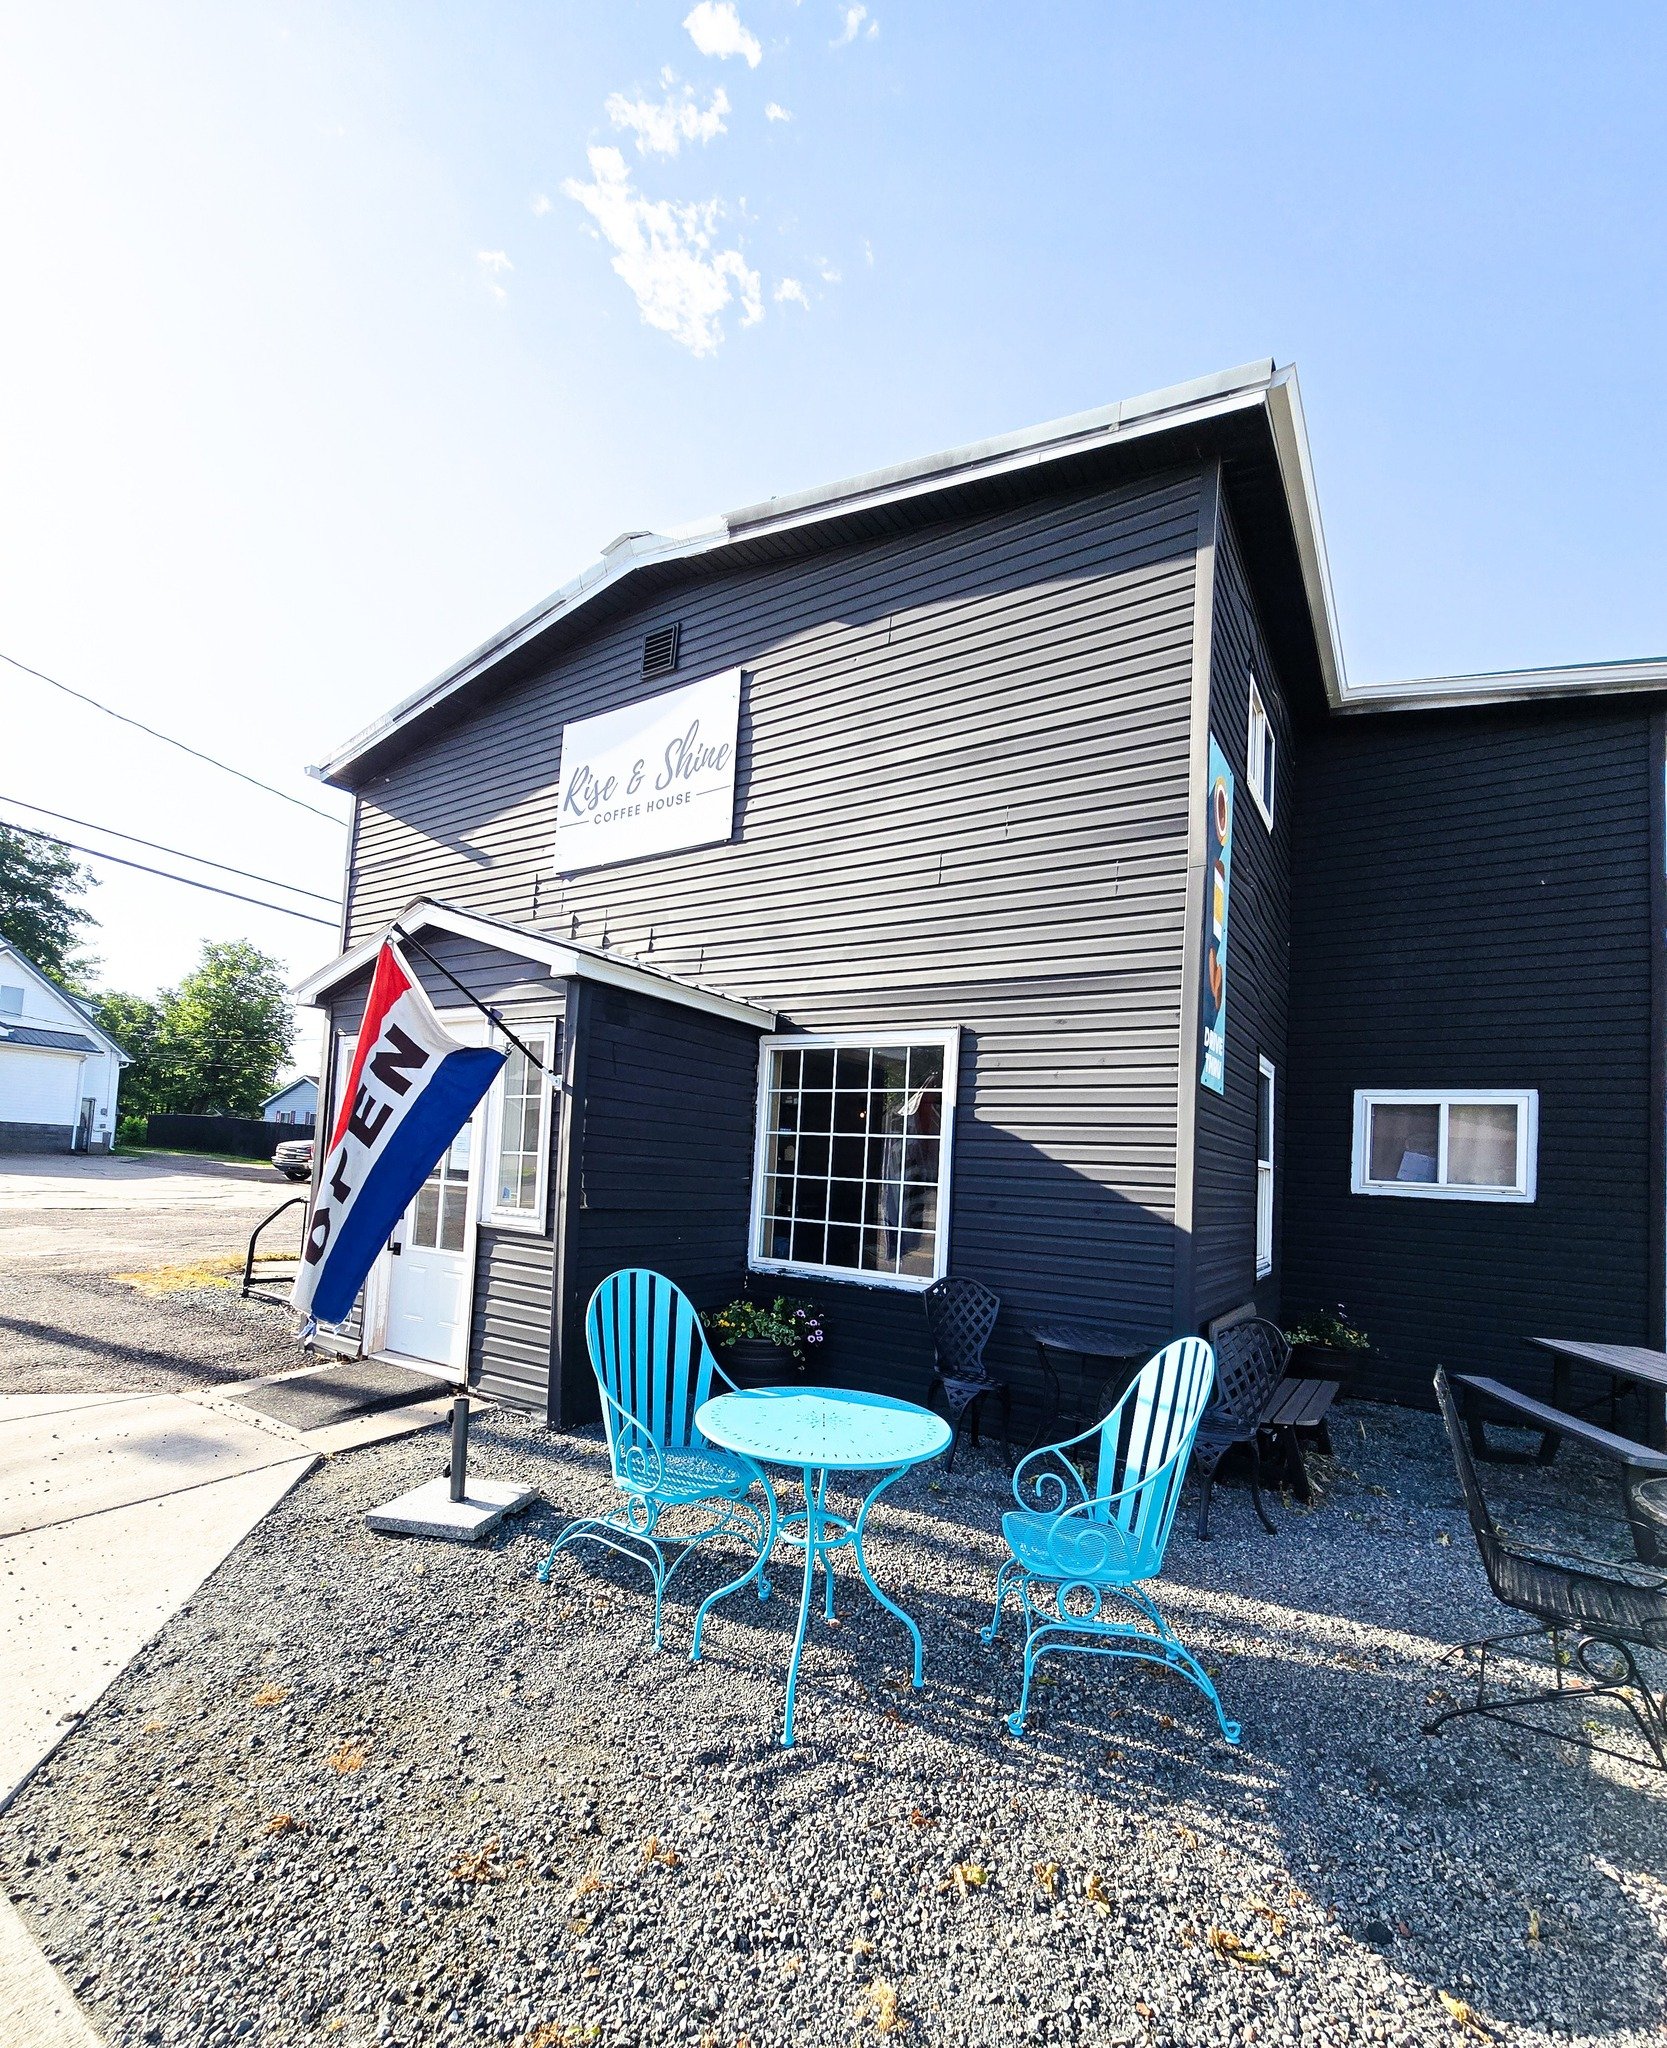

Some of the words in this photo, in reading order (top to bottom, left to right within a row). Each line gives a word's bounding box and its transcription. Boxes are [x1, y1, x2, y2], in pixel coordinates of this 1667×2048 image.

[563, 765, 618, 816] Rise
[627, 759, 645, 794] &
[655, 719, 732, 790] Shine
[594, 804, 641, 824] COFFEE
[646, 792, 691, 813] HOUSE
